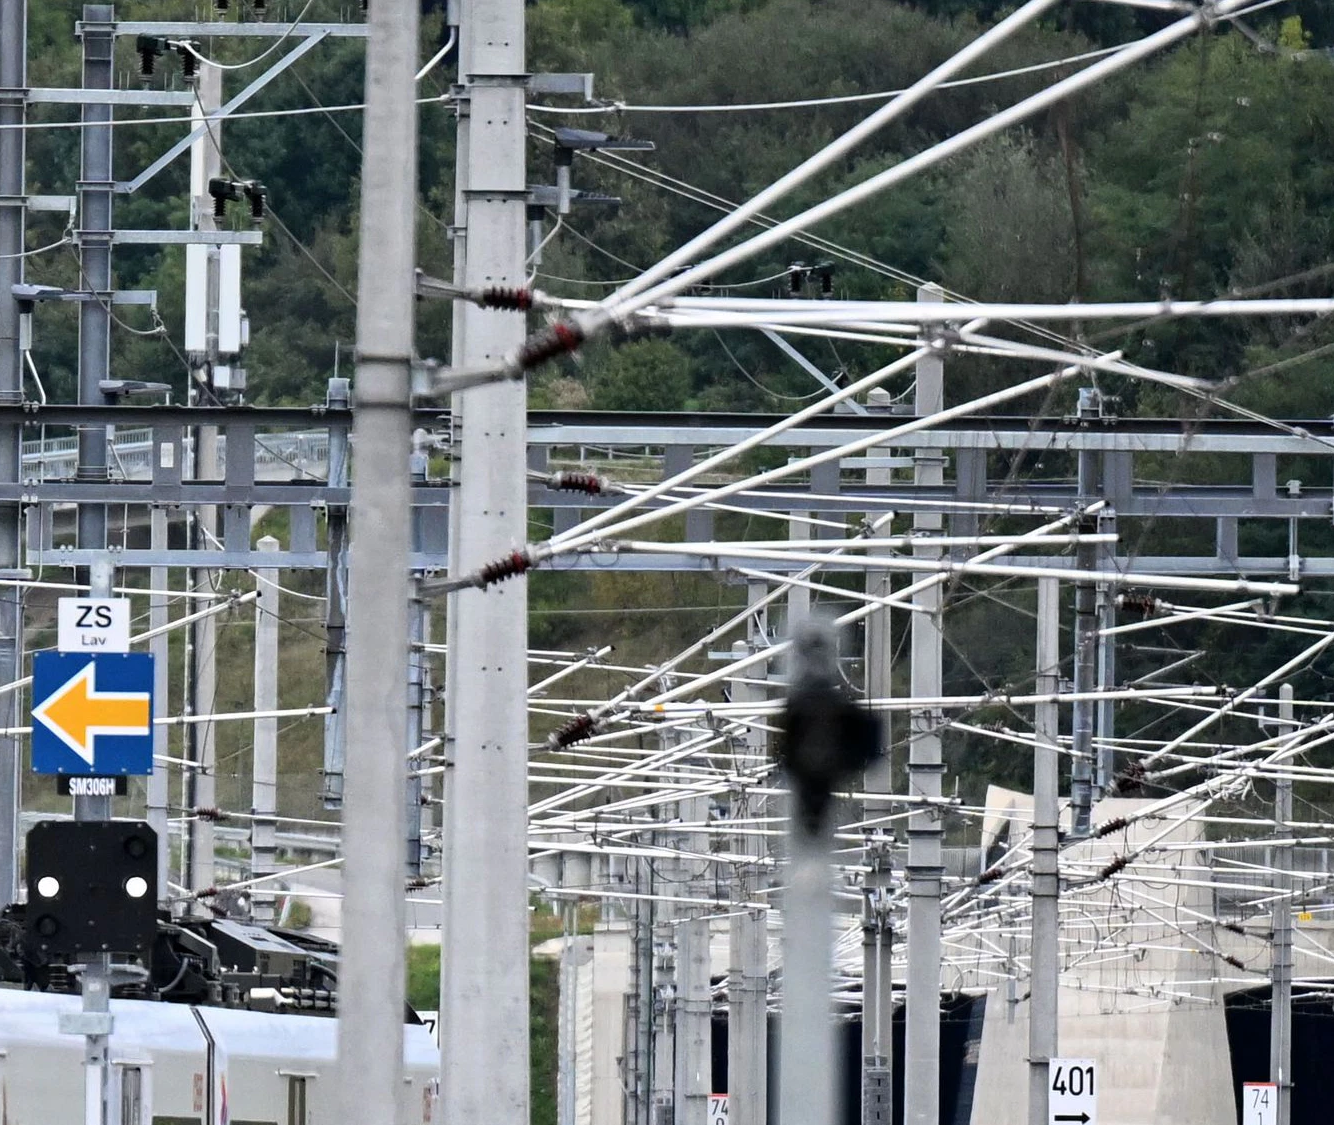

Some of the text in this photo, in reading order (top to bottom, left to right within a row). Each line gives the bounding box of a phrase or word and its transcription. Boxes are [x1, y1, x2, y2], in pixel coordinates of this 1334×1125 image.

[75, 605, 112, 628] ZS
[81, 633, 107, 646] Lav
[69, 777, 116, 796] SM306H
[1052, 1066, 1094, 1096] 401
[712, 1099, 728, 1116] 74
[1252, 1089, 1269, 1108] 74
